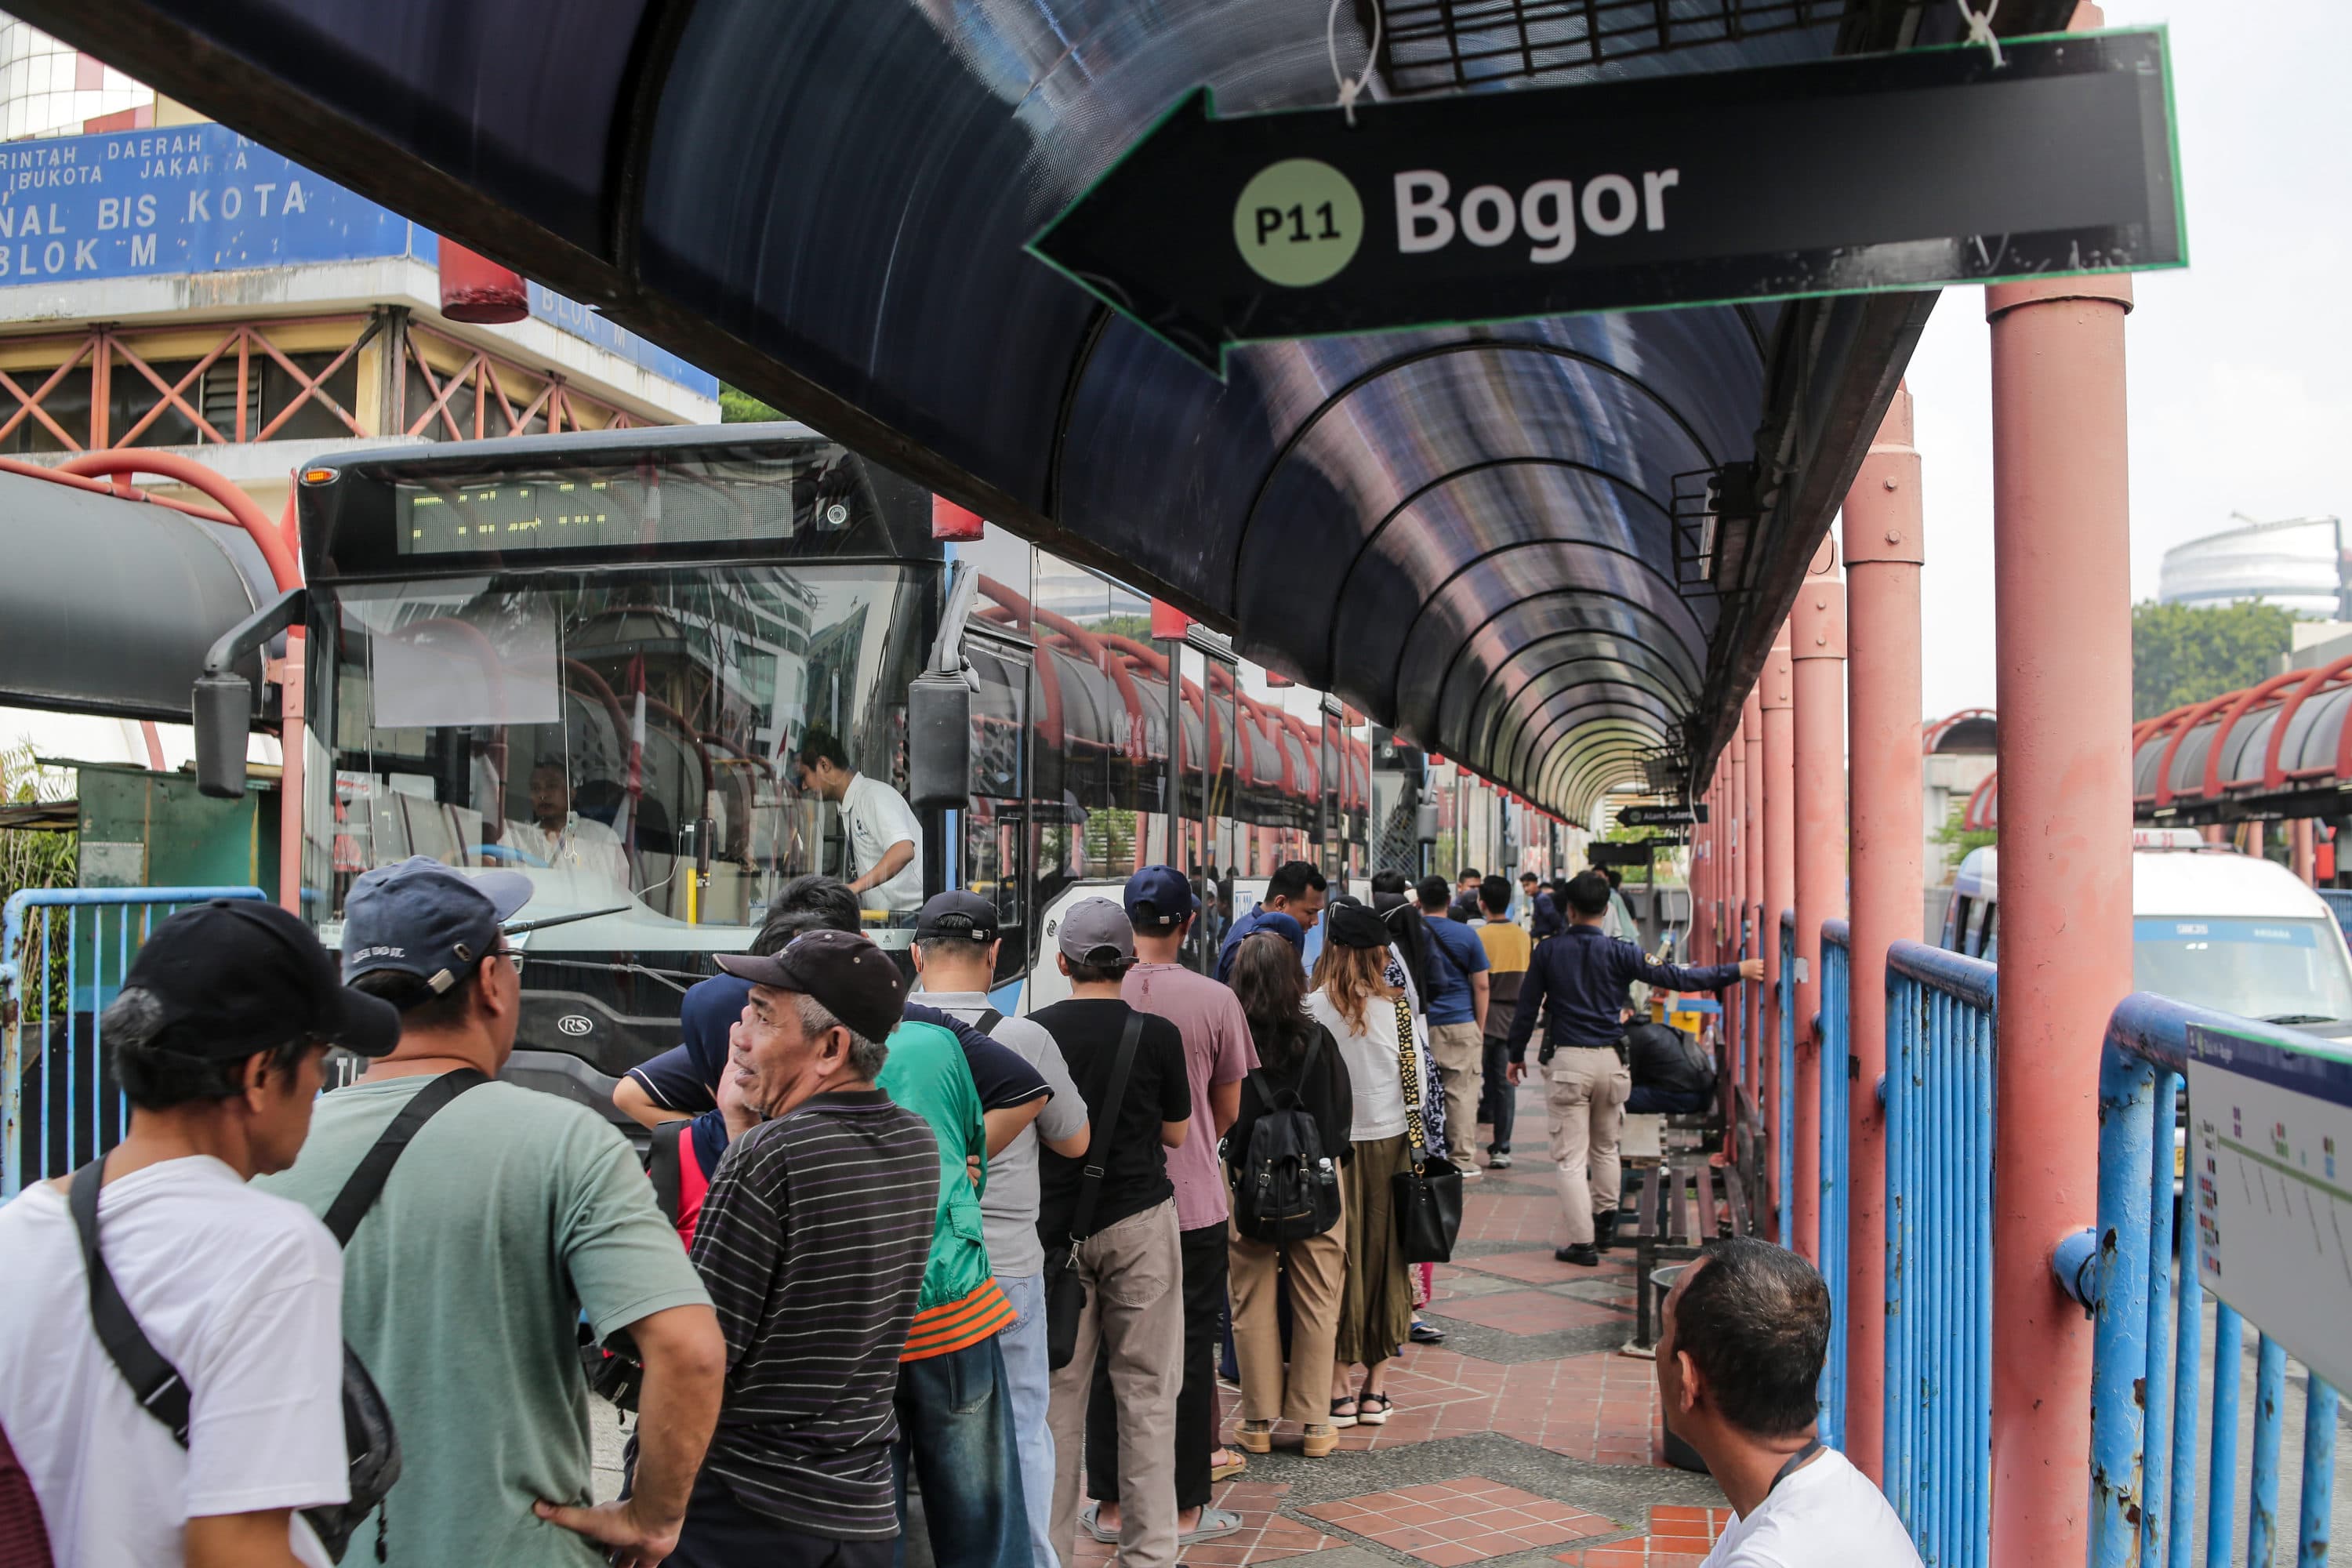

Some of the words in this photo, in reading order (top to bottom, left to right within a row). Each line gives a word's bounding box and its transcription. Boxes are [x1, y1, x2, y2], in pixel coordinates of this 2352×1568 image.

[107, 134, 201, 160] DAERAH
[9, 165, 102, 191] IBUKOTA
[98, 194, 157, 230] BIS
[188, 180, 306, 223] KOTA
[1255, 201, 1341, 245] P11
[1393, 168, 1679, 264] Bogor
[131, 233, 157, 267] M
[371, 946, 390, 956] DO
[564, 1018, 588, 1033] RS
